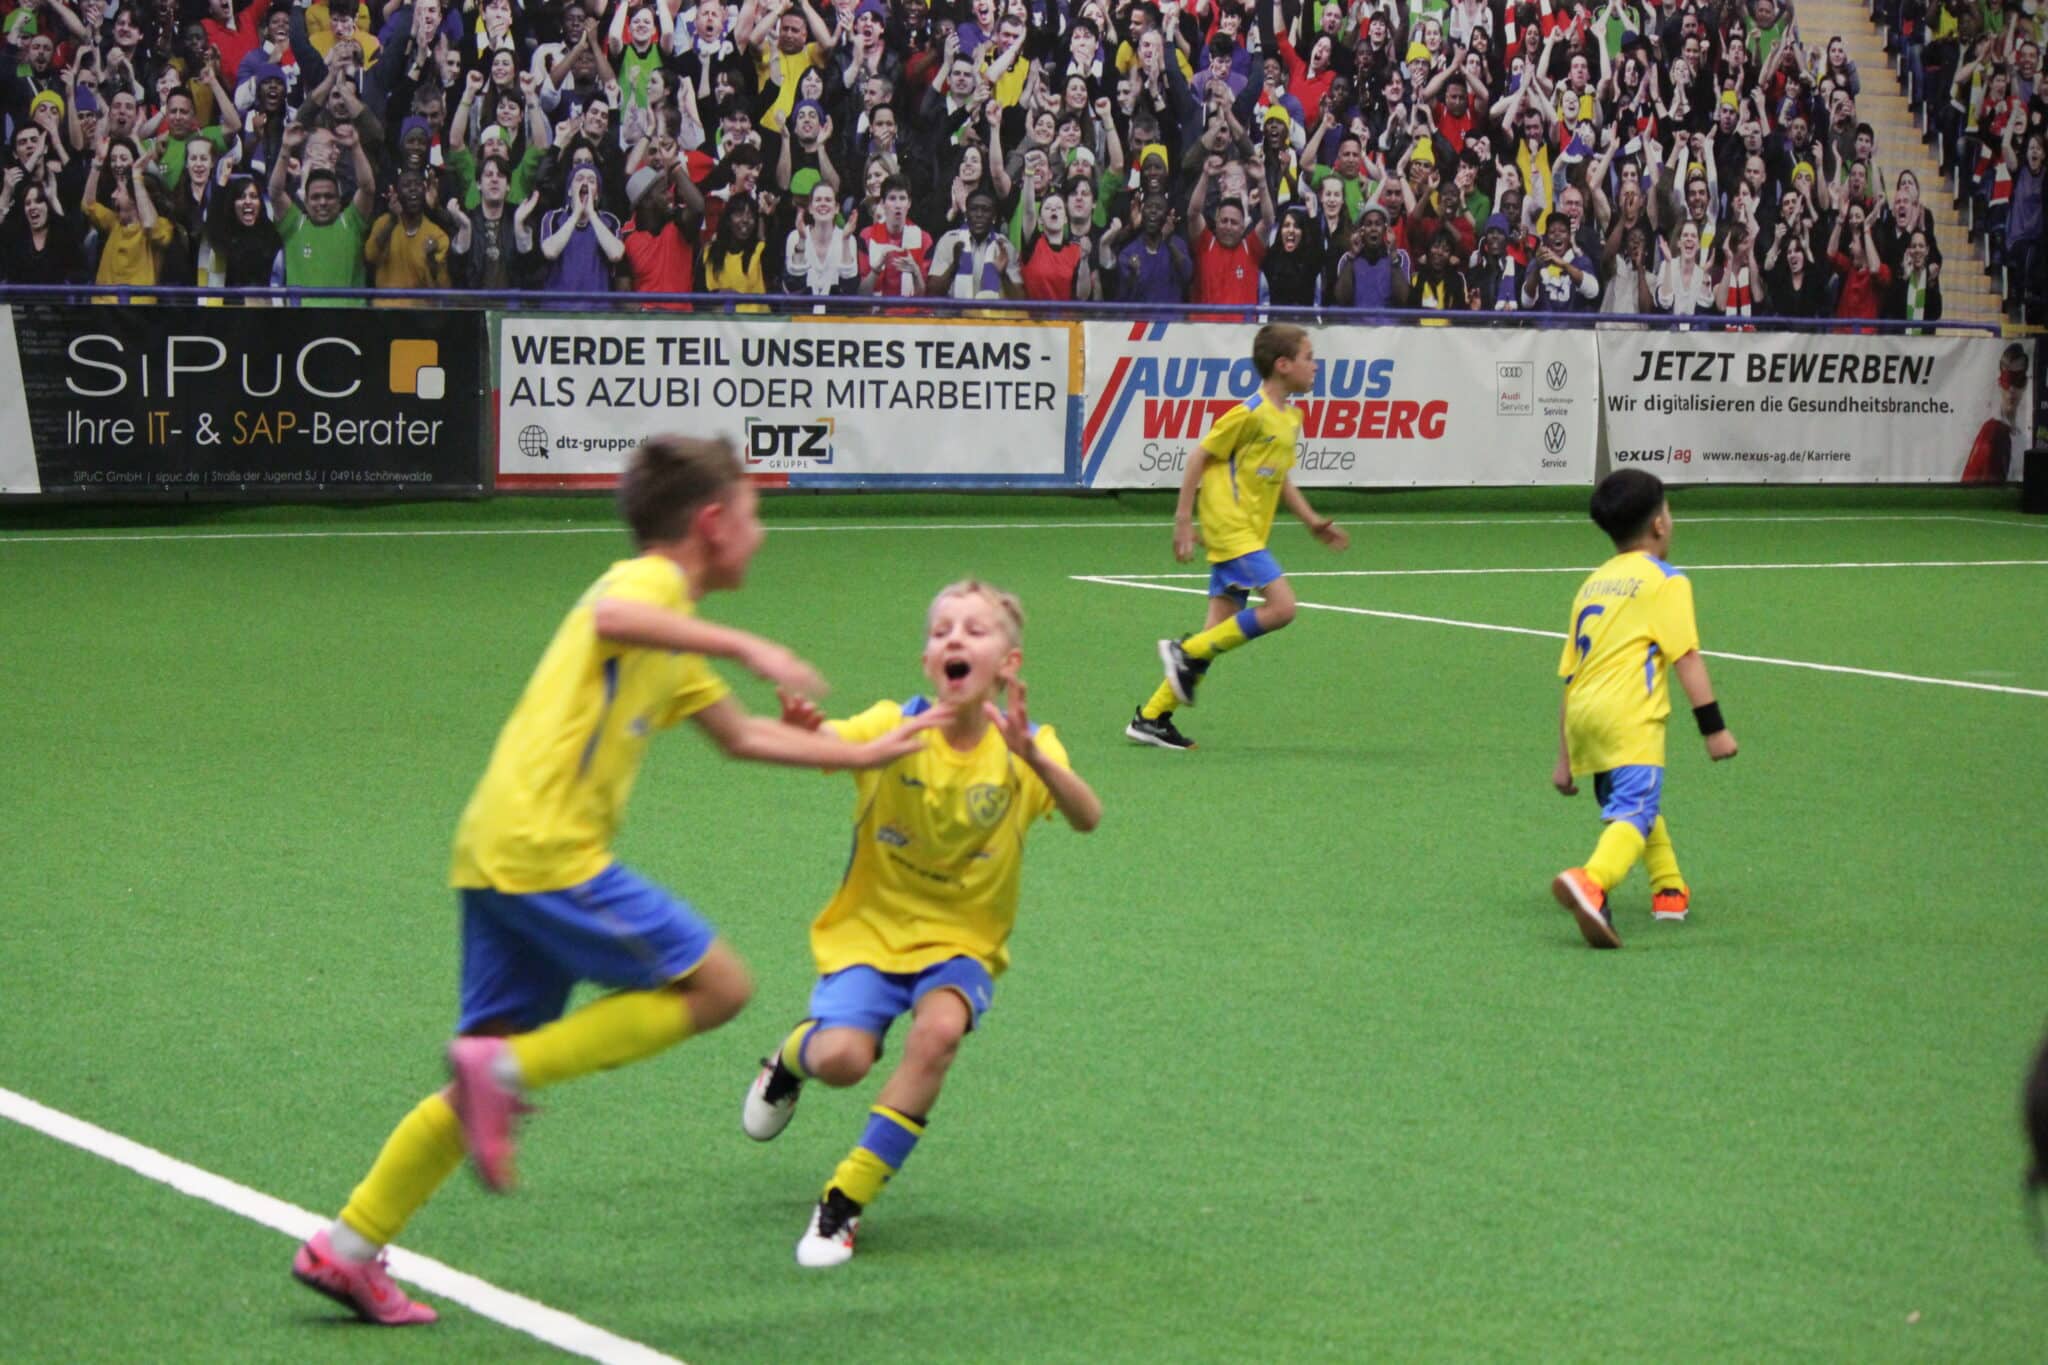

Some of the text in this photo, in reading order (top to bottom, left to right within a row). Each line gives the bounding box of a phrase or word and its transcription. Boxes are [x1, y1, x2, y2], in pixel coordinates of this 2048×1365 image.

[512, 335, 645, 365] WERDE
[656, 337, 730, 366] TEIL
[742, 338, 905, 368] UNSERES
[915, 341, 1031, 370] TEAMS
[1127, 356, 1395, 399] AUTOAUS
[1633, 350, 1935, 385] JETZT BEWERBEN!
[509, 376, 1056, 410] ALS AZUBI ODER MITARBEITER
[1501, 392, 1521, 401] Audi
[1500, 402, 1530, 412] Service
[1543, 407, 1568, 416] Service
[1608, 394, 1955, 415] Wir digitalisieren die Gesundheitsbranche.
[67, 410, 443, 446] Ihre IT- & SAP-Berater
[1143, 399, 1449, 440] WITNBERG
[556, 435, 649, 452] dtz-gruppe.d
[751, 425, 827, 457] DTZ
[769, 460, 809, 469] GRUPPE
[1139, 443, 1187, 472] Seit
[1541, 458, 1568, 469] Service
[1702, 449, 1851, 464] www.nexus-ag.de/Karriere
[106, 471, 142, 482] GmbH
[155, 471, 200, 484] sipuc.de
[243, 471, 261, 482] der
[263, 471, 302, 484] Jugend
[330, 471, 362, 482] 04916
[364, 471, 433, 482] Schönewalde
